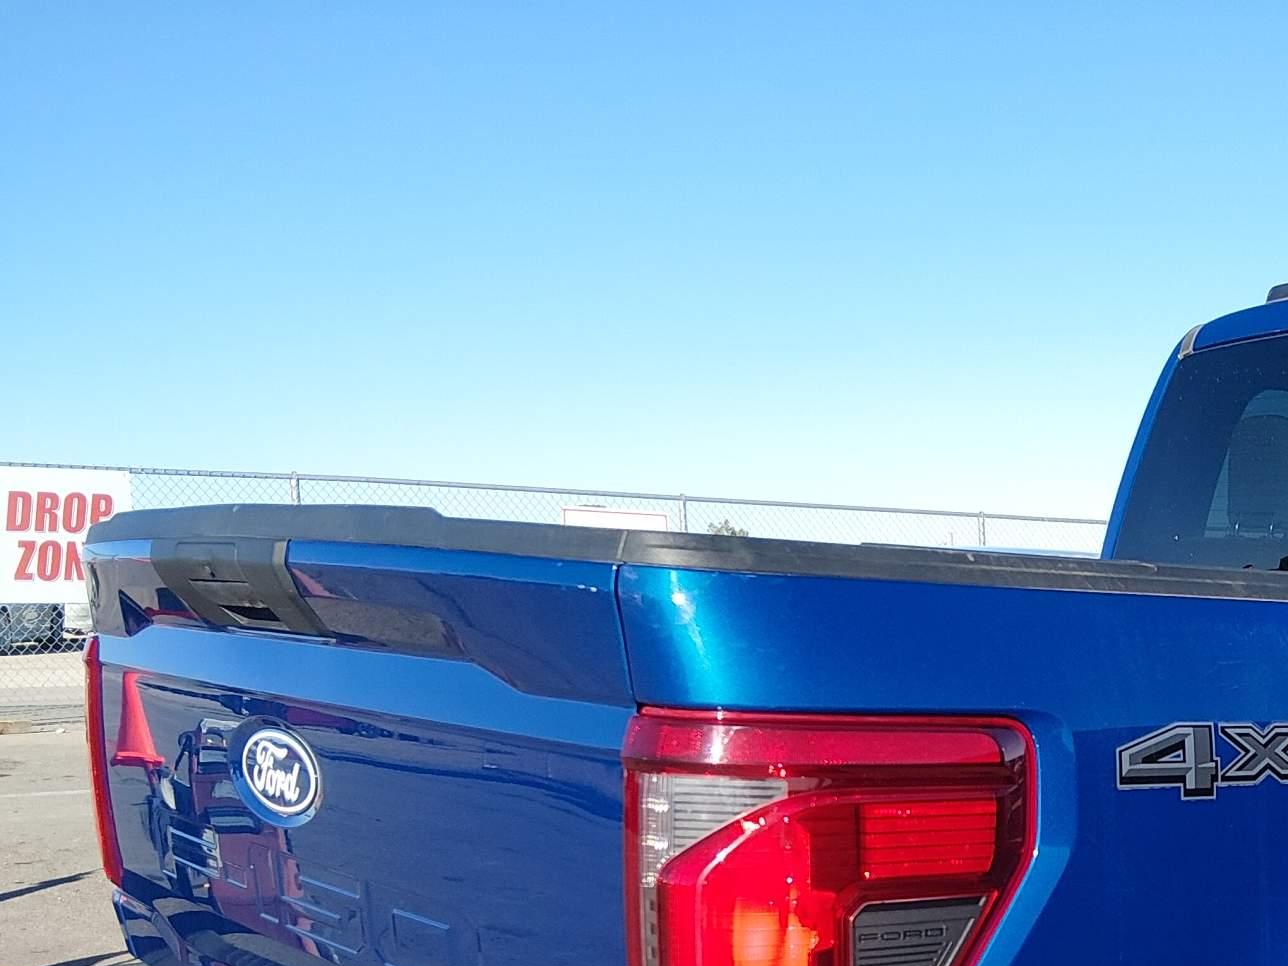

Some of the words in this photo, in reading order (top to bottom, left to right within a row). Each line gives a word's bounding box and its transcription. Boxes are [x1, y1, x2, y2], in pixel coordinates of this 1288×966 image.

[6, 490, 115, 533] DROP
[15, 540, 85, 581] ZON
[253, 740, 300, 803] Ford
[858, 926, 946, 942] FORD
